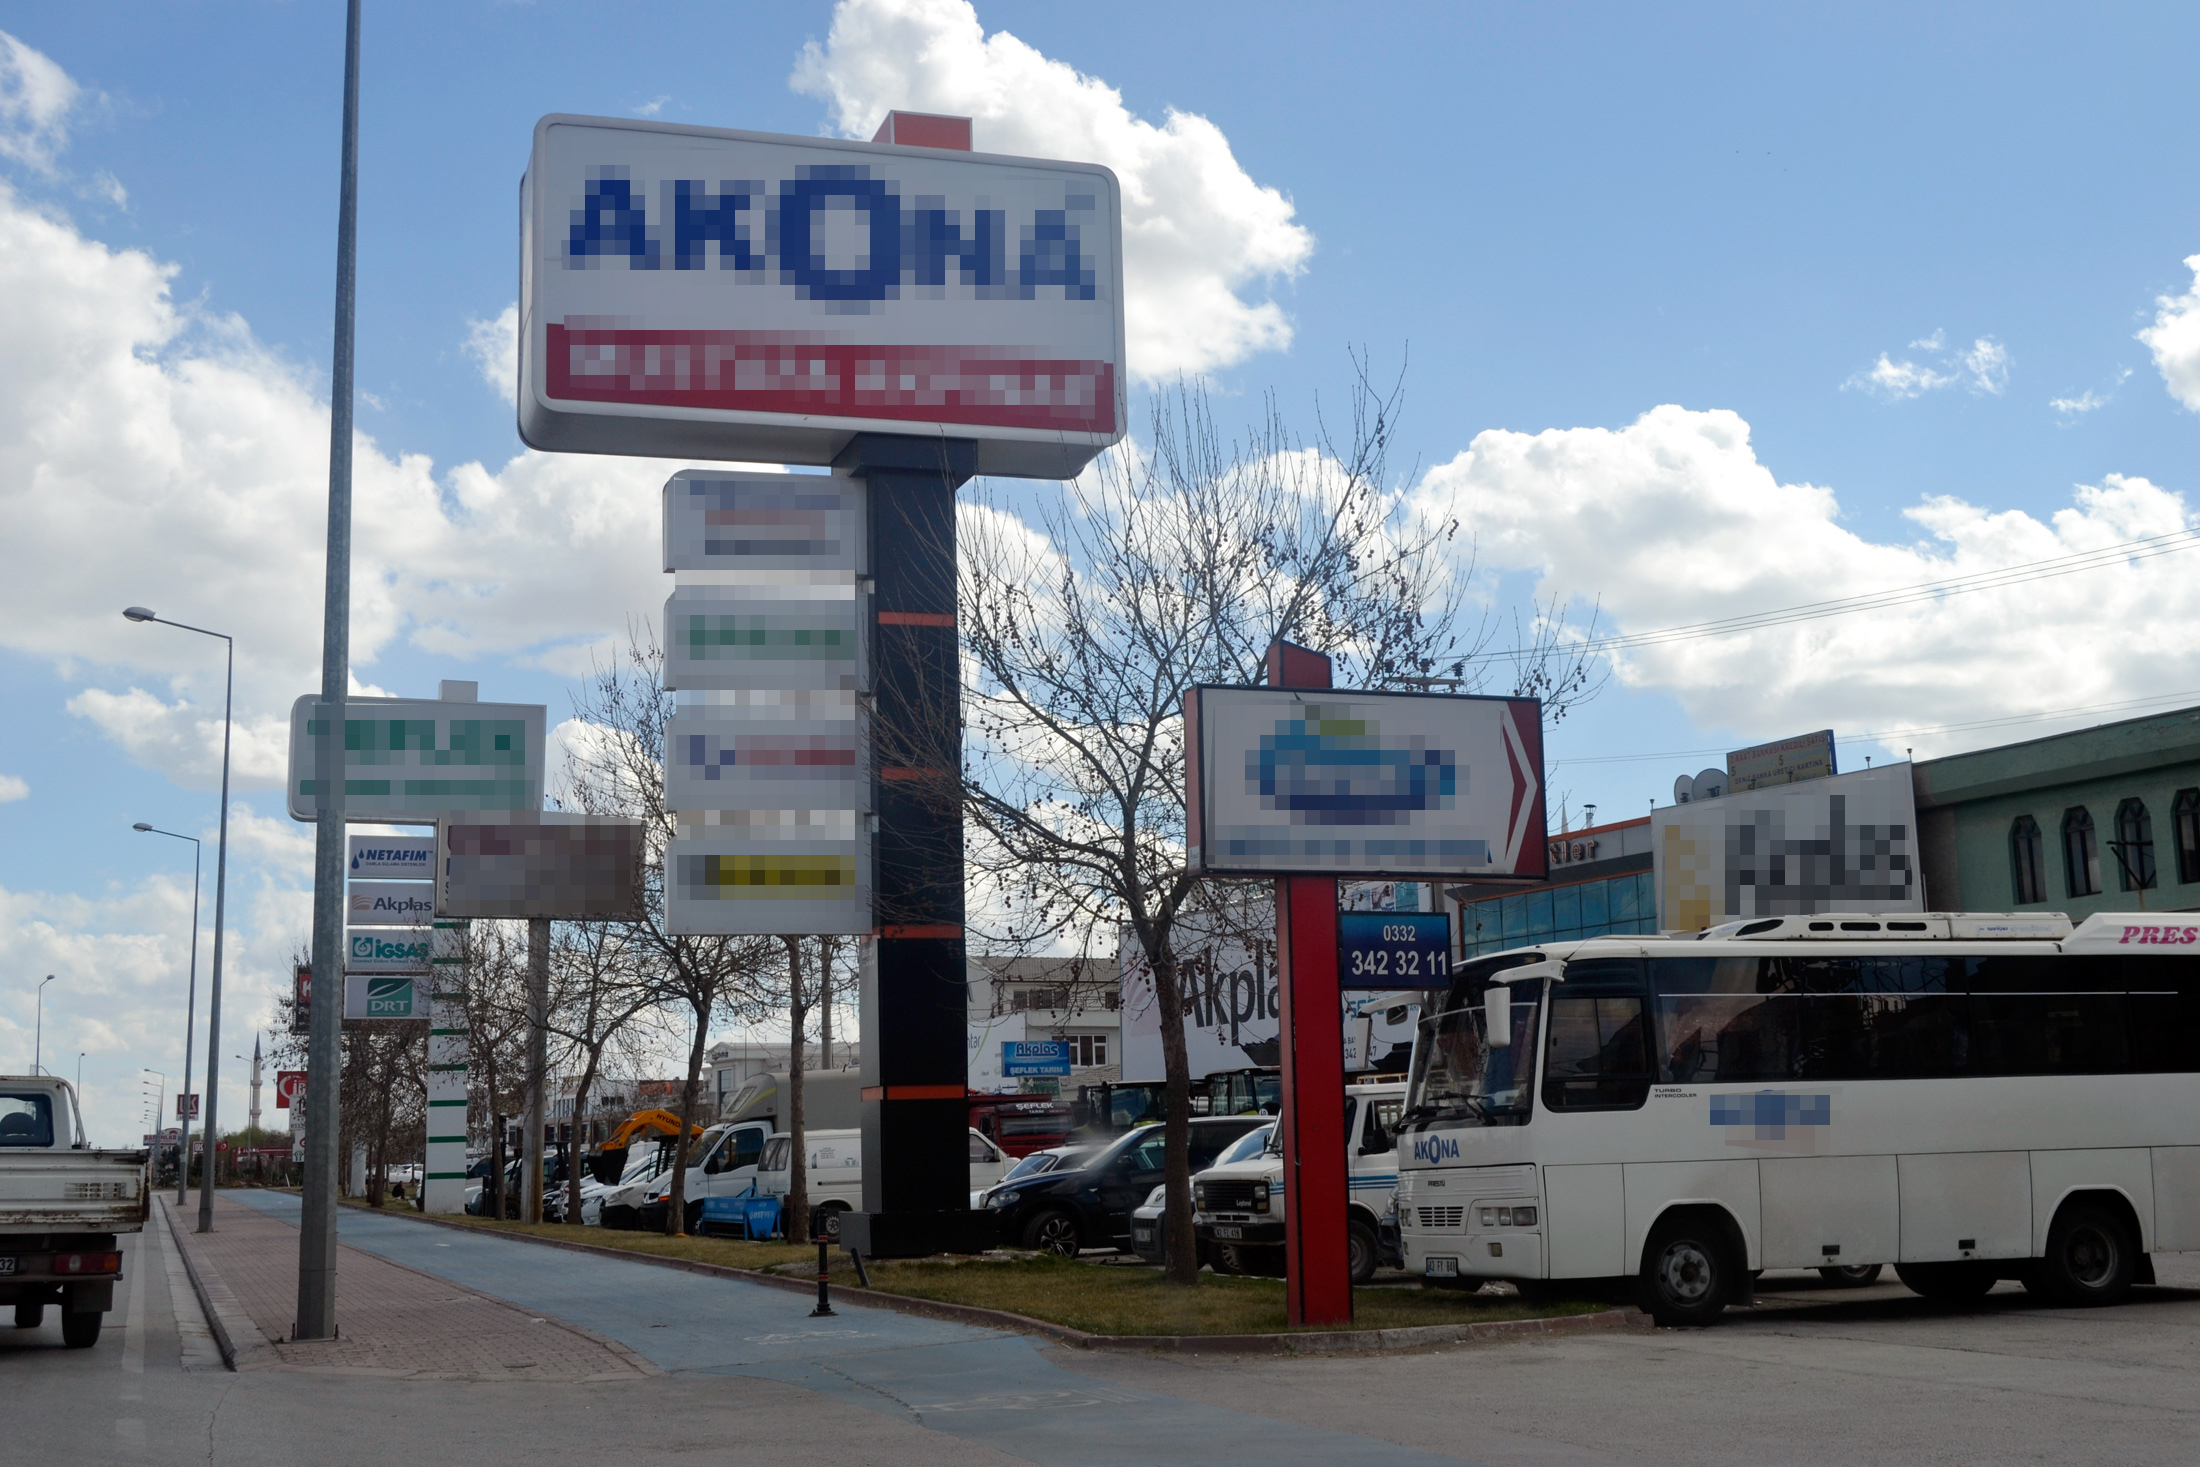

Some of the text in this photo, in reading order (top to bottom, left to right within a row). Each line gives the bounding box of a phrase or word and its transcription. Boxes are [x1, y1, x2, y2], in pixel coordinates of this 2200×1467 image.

[373, 897, 432, 914] Akplas
[1383, 925, 1416, 942] 0332
[1351, 950, 1447, 976] 342 32 11
[371, 1000, 409, 1012] DRT
[1016, 1042, 1059, 1057] Akplas
[1010, 1066, 1039, 1076] ŞEFLEK
[1015, 1102, 1054, 1111] ŞEFLEK
[1414, 1134, 1460, 1164] AKONA
